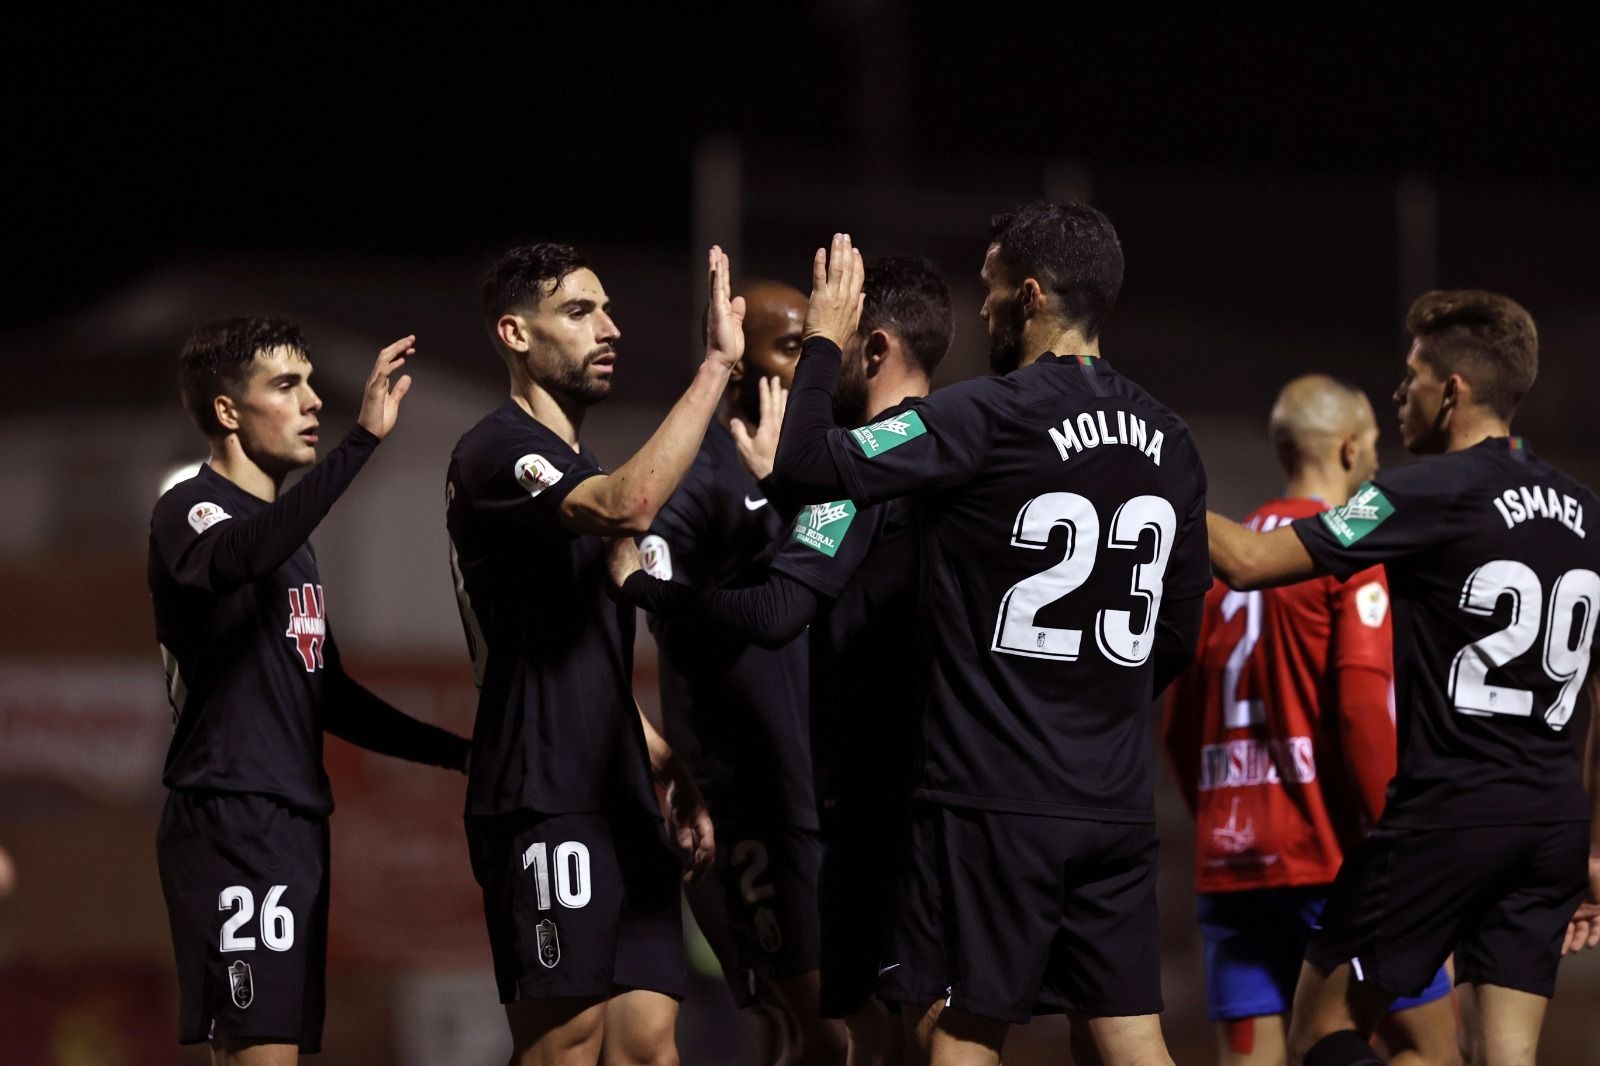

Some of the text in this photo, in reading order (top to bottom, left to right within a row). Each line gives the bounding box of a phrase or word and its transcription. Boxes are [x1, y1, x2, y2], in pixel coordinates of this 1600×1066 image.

[1048, 410, 1165, 467] MOLINA
[806, 528, 835, 549] RURAL
[1493, 484, 1587, 538] ISMAEL
[991, 491, 1177, 668] 23
[1447, 559, 1600, 732] 29
[522, 840, 592, 911] 10
[218, 885, 295, 953] 26
